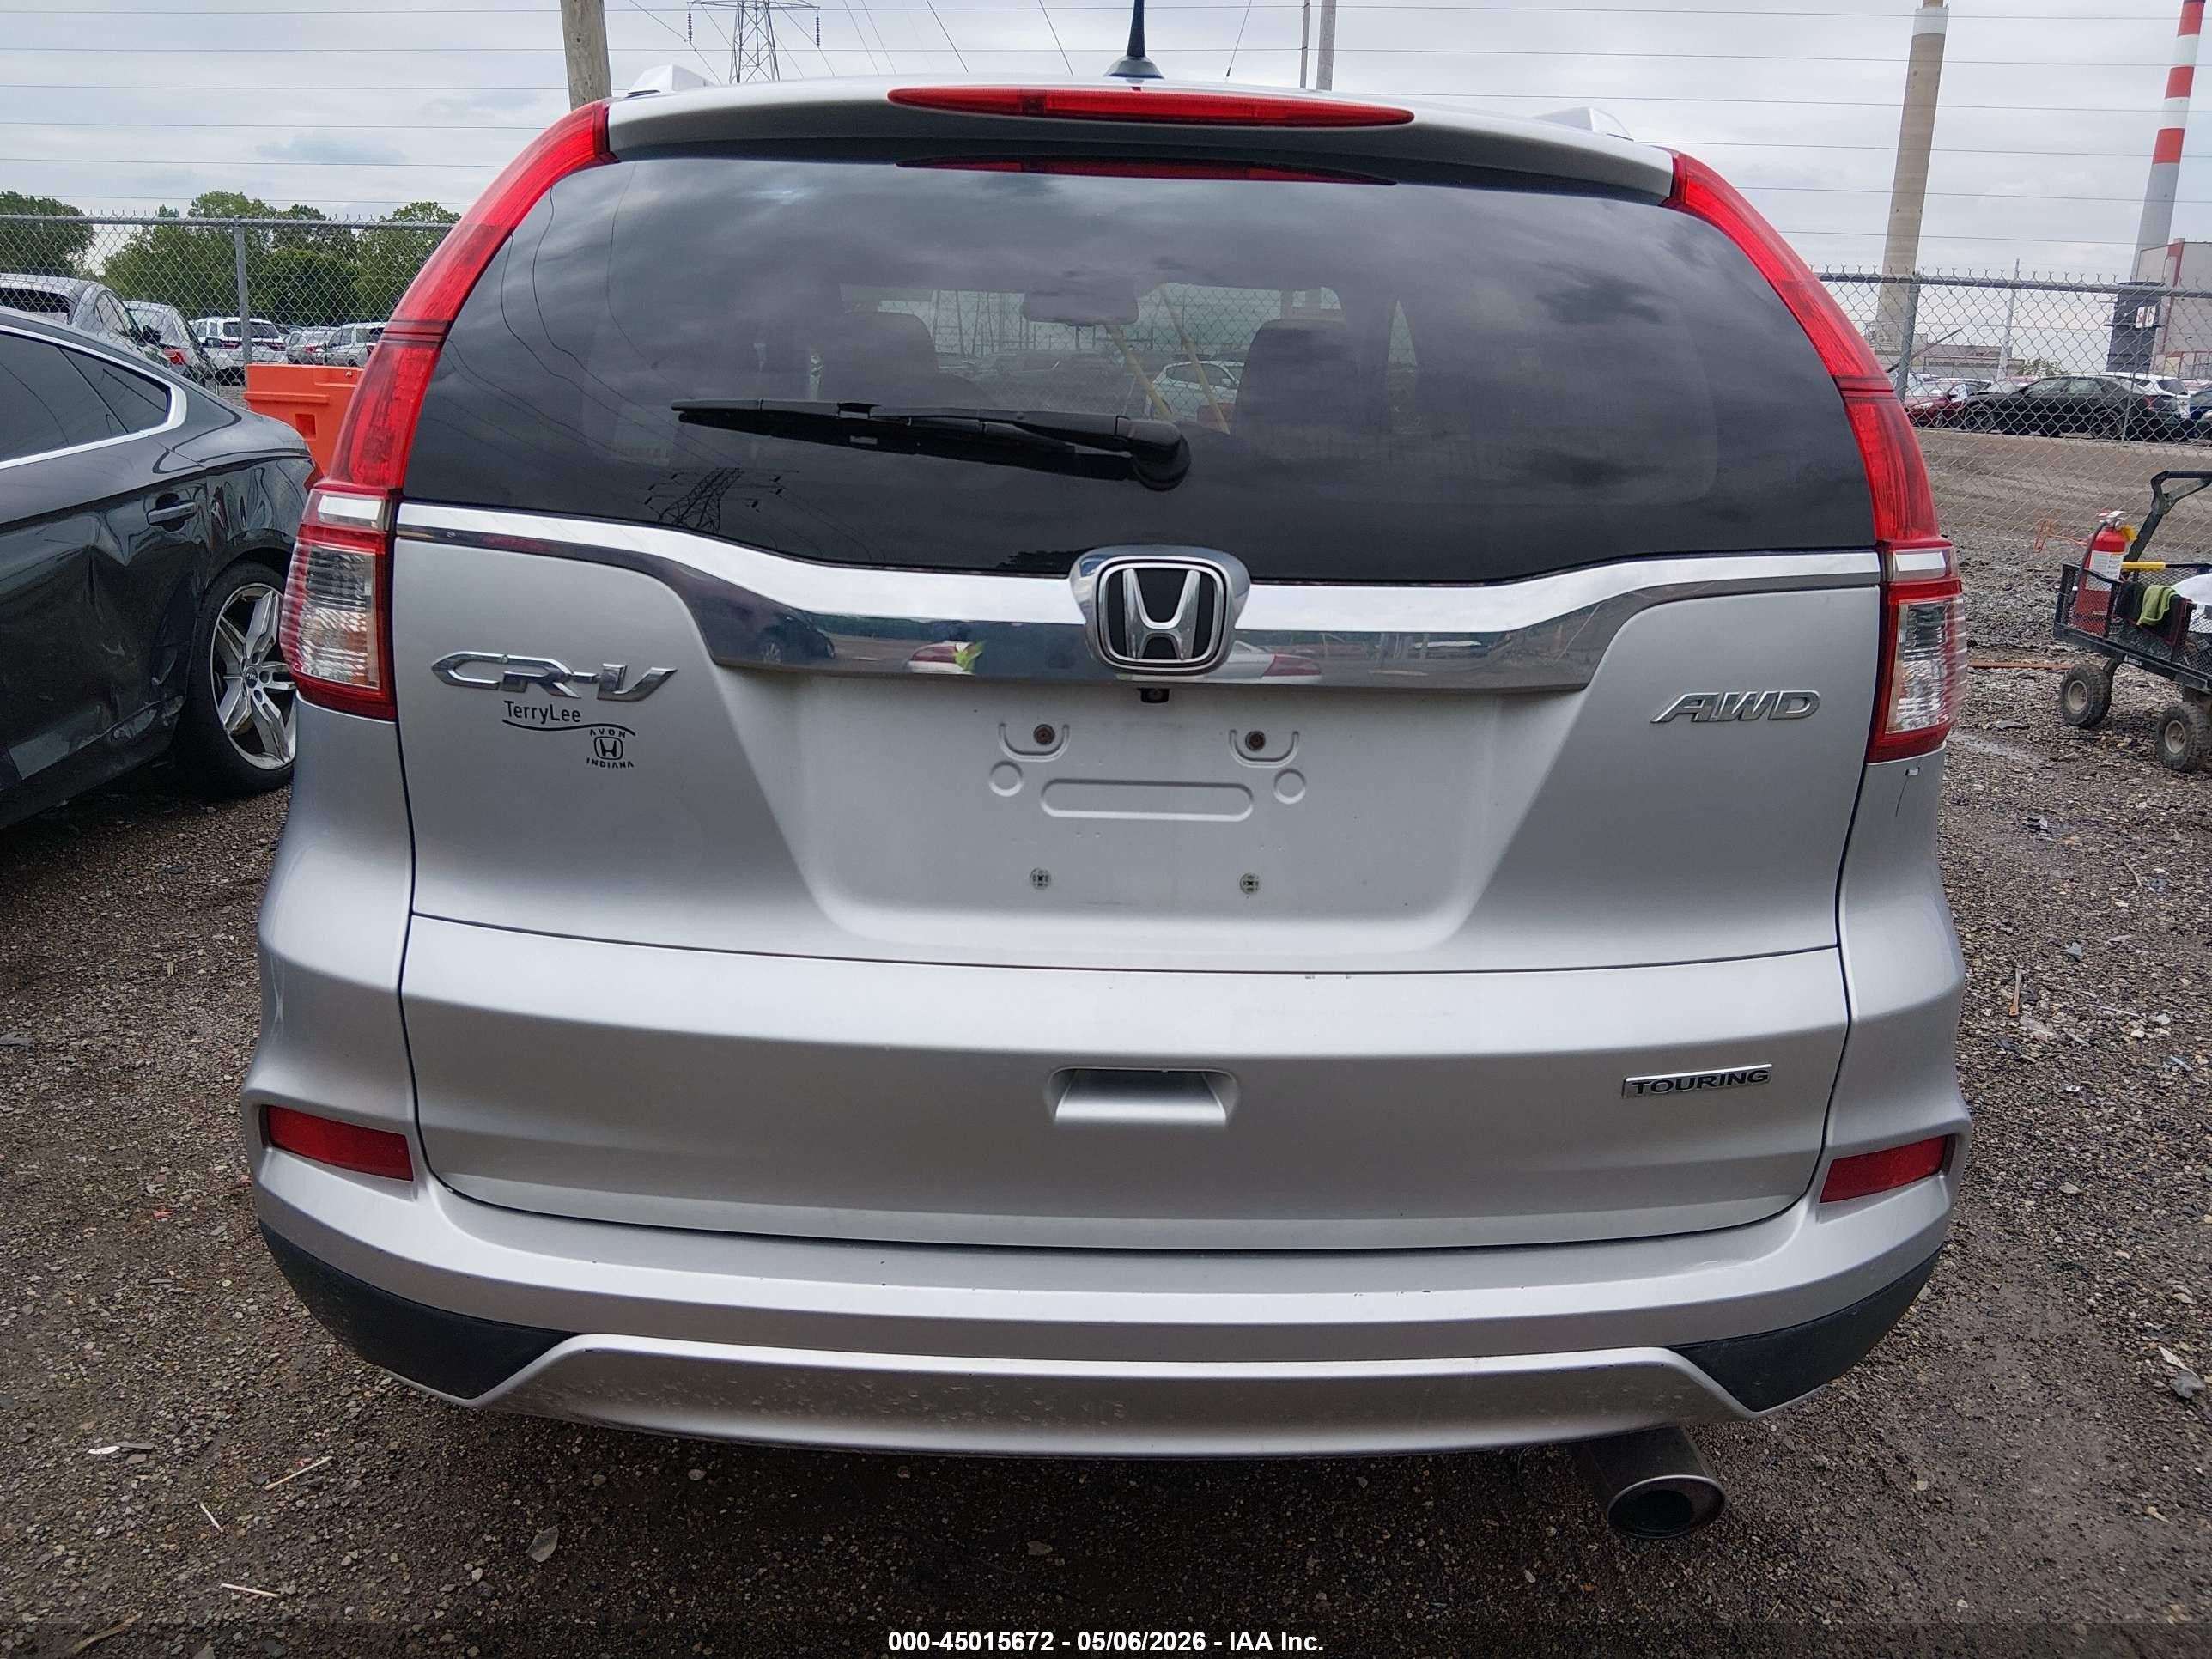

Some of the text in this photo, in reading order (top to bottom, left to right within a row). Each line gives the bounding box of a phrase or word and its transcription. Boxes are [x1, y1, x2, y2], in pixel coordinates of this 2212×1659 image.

[431, 651, 678, 702] CR-V
[503, 700, 581, 725] TerryLee
[1650, 690, 1820, 723] AWD
[590, 727, 626, 738] AVON
[586, 757, 635, 769] INDIANA
[1632, 1070, 1769, 1095] TOURING
